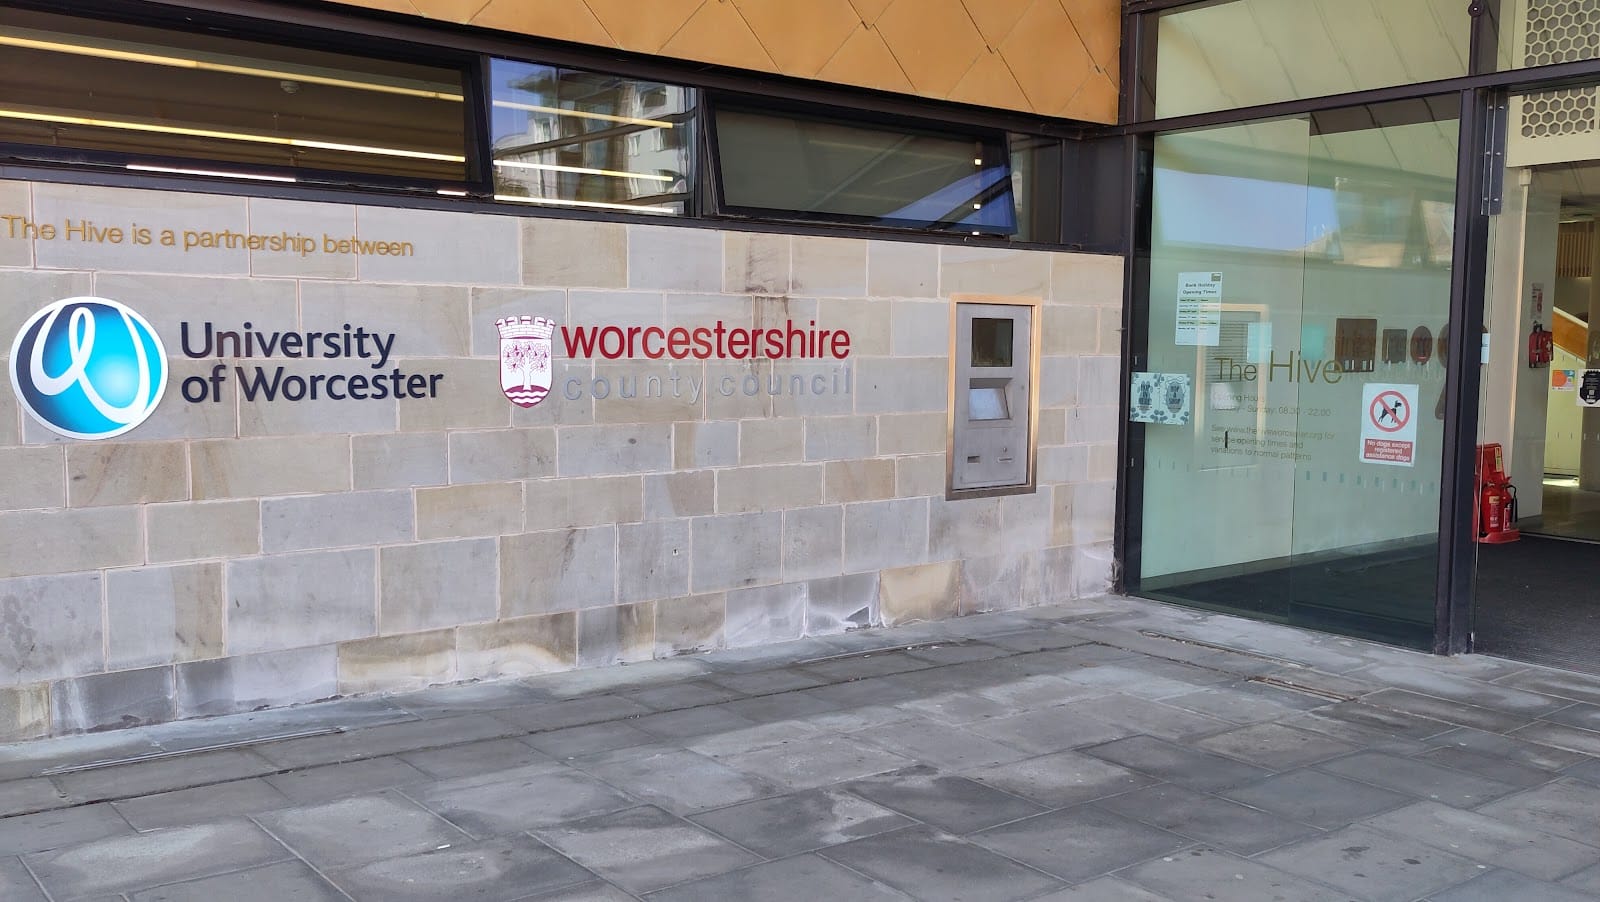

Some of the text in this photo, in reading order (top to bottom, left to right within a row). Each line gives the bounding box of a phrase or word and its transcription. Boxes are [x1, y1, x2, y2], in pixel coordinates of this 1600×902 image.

[0, 215, 414, 257] The Hive is a partnership between
[180, 321, 395, 369] University
[561, 319, 851, 360] worcestershire
[181, 364, 444, 404] of Worcester
[563, 367, 851, 404] county council
[1214, 350, 1343, 384] The Hive
